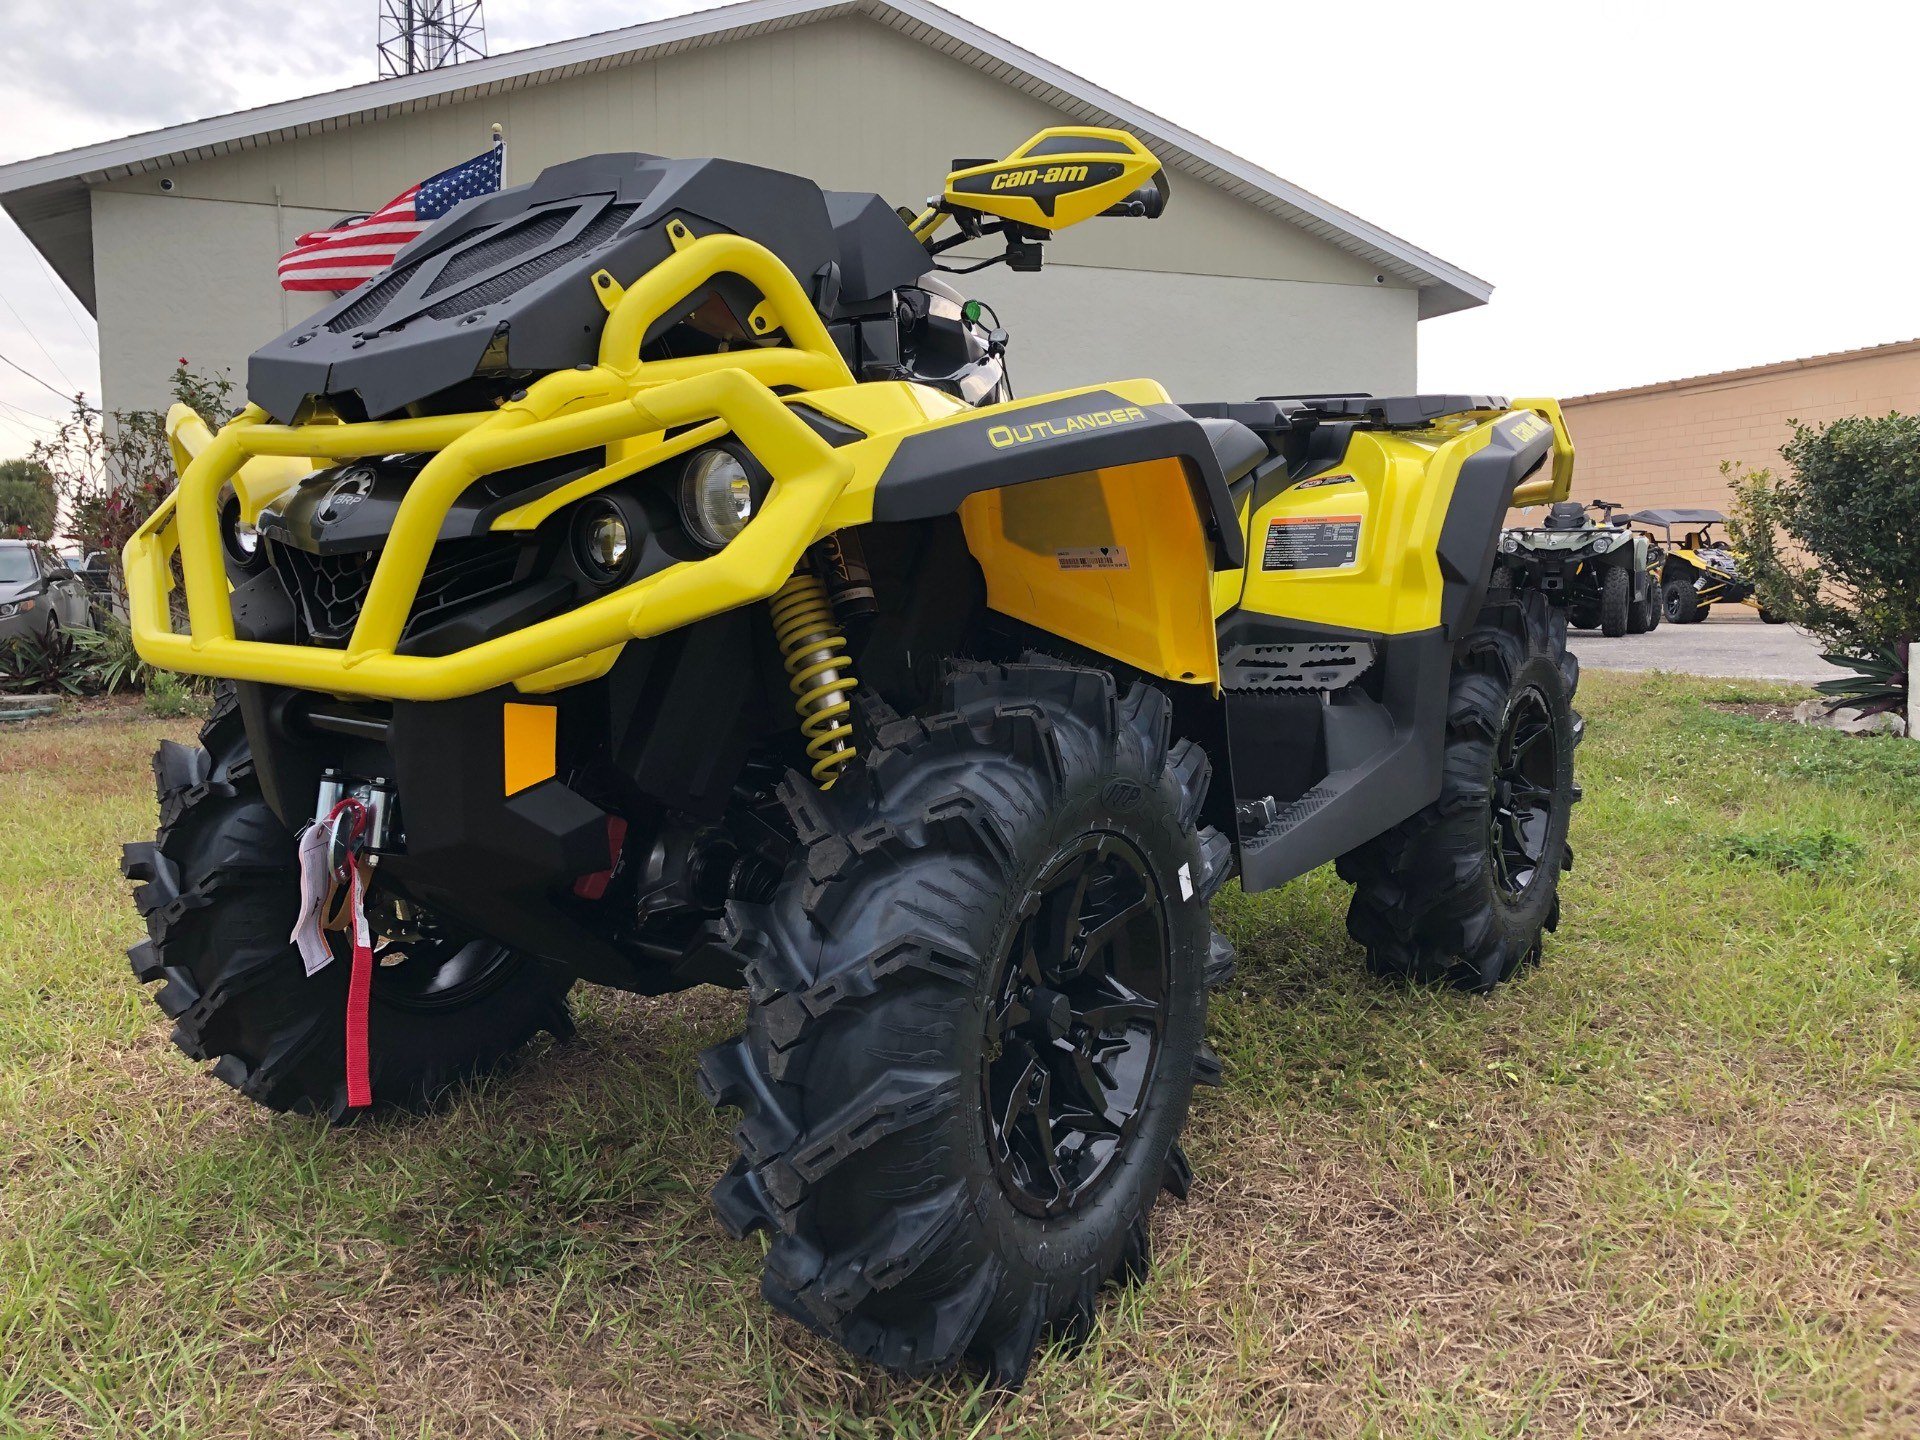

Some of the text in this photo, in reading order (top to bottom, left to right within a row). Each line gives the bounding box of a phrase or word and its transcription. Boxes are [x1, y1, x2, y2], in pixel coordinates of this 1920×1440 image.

[992, 166, 1088, 190] can-am
[988, 408, 1145, 448] OUTLANDER
[336, 496, 362, 505] BRP
